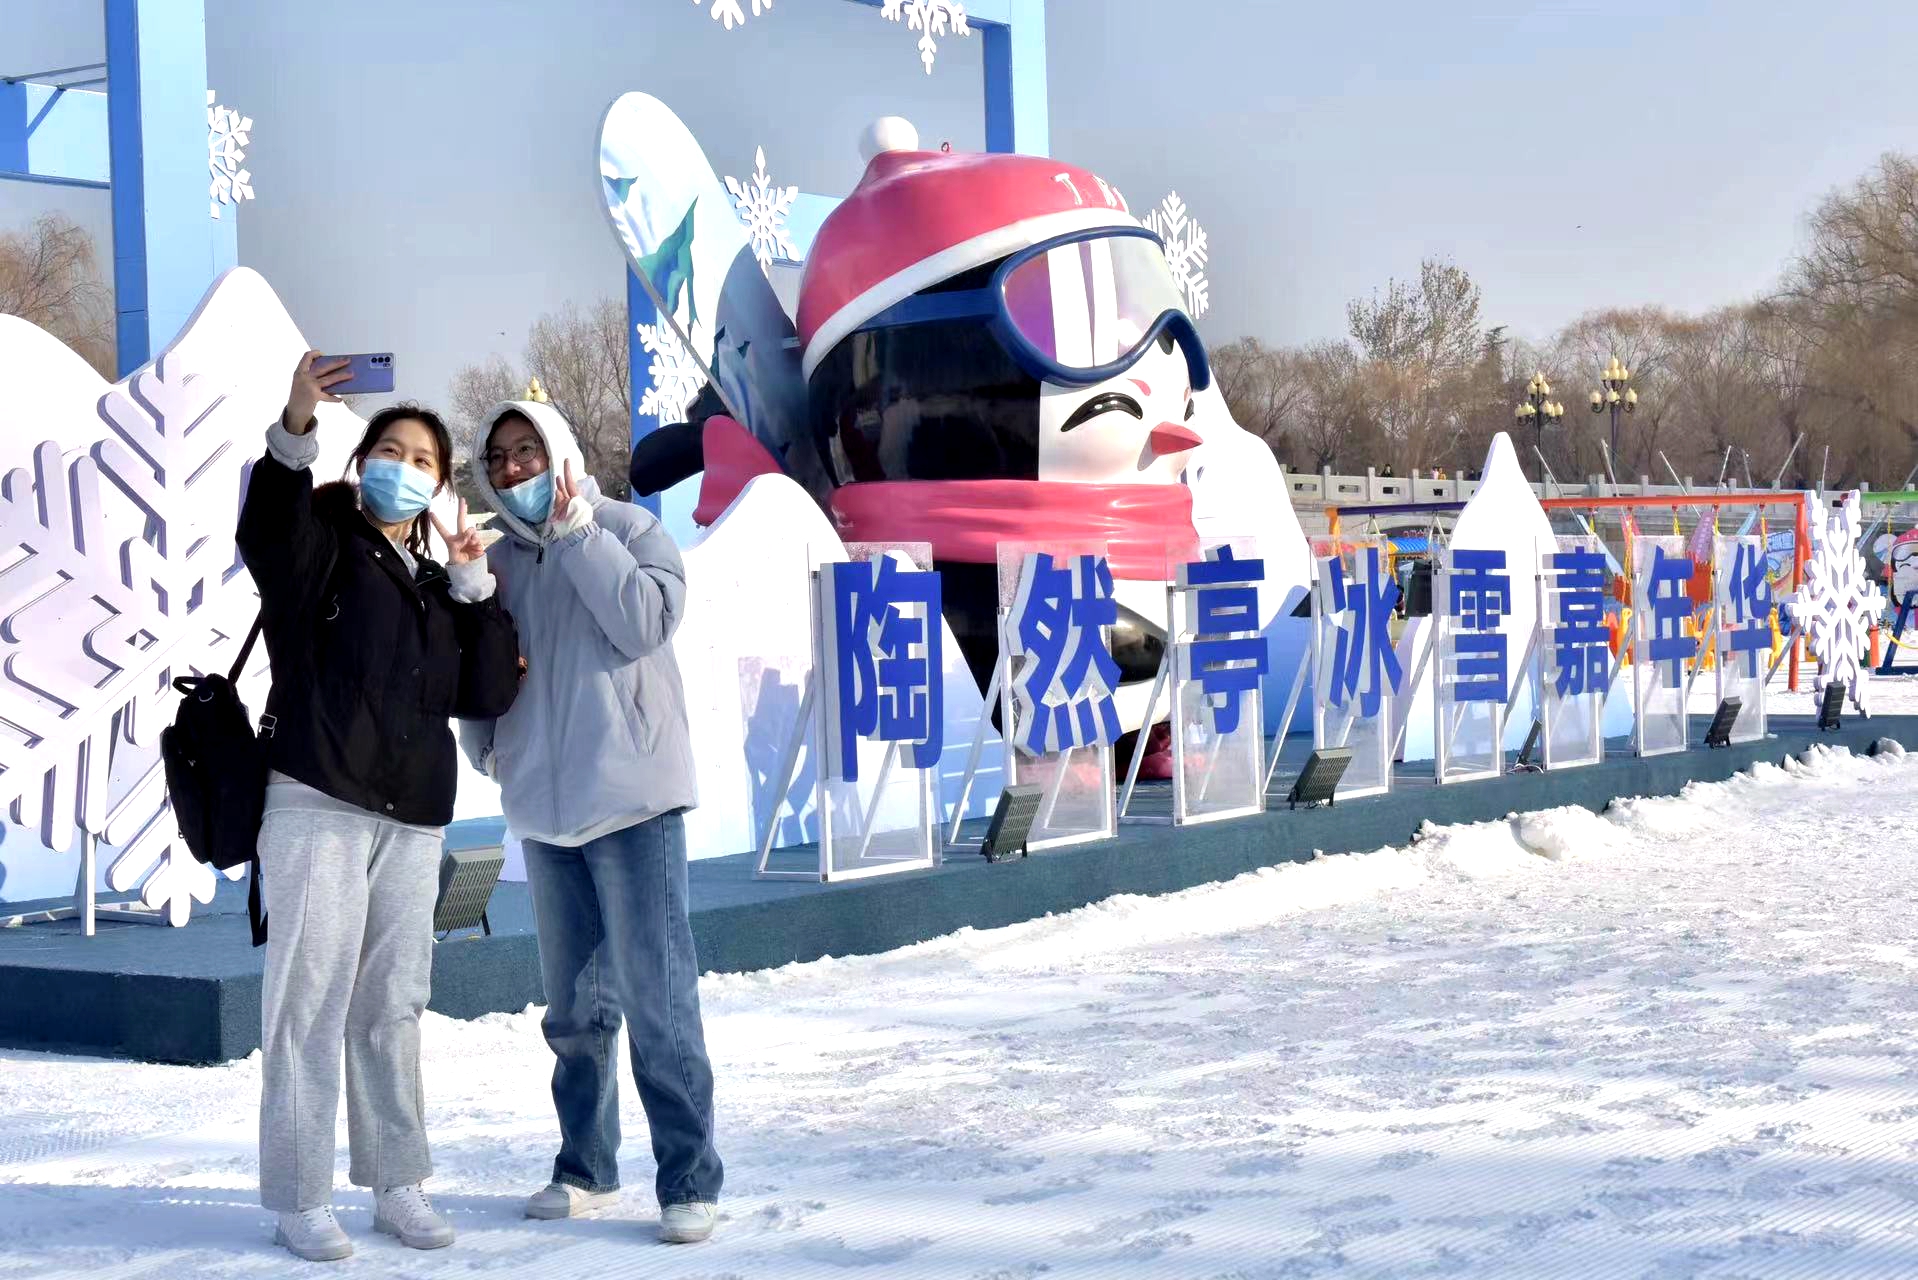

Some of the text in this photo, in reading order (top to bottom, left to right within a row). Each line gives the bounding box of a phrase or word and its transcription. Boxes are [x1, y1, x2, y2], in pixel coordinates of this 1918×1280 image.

[824, 543, 1772, 782] 陶然亭冰雪嘉年华
